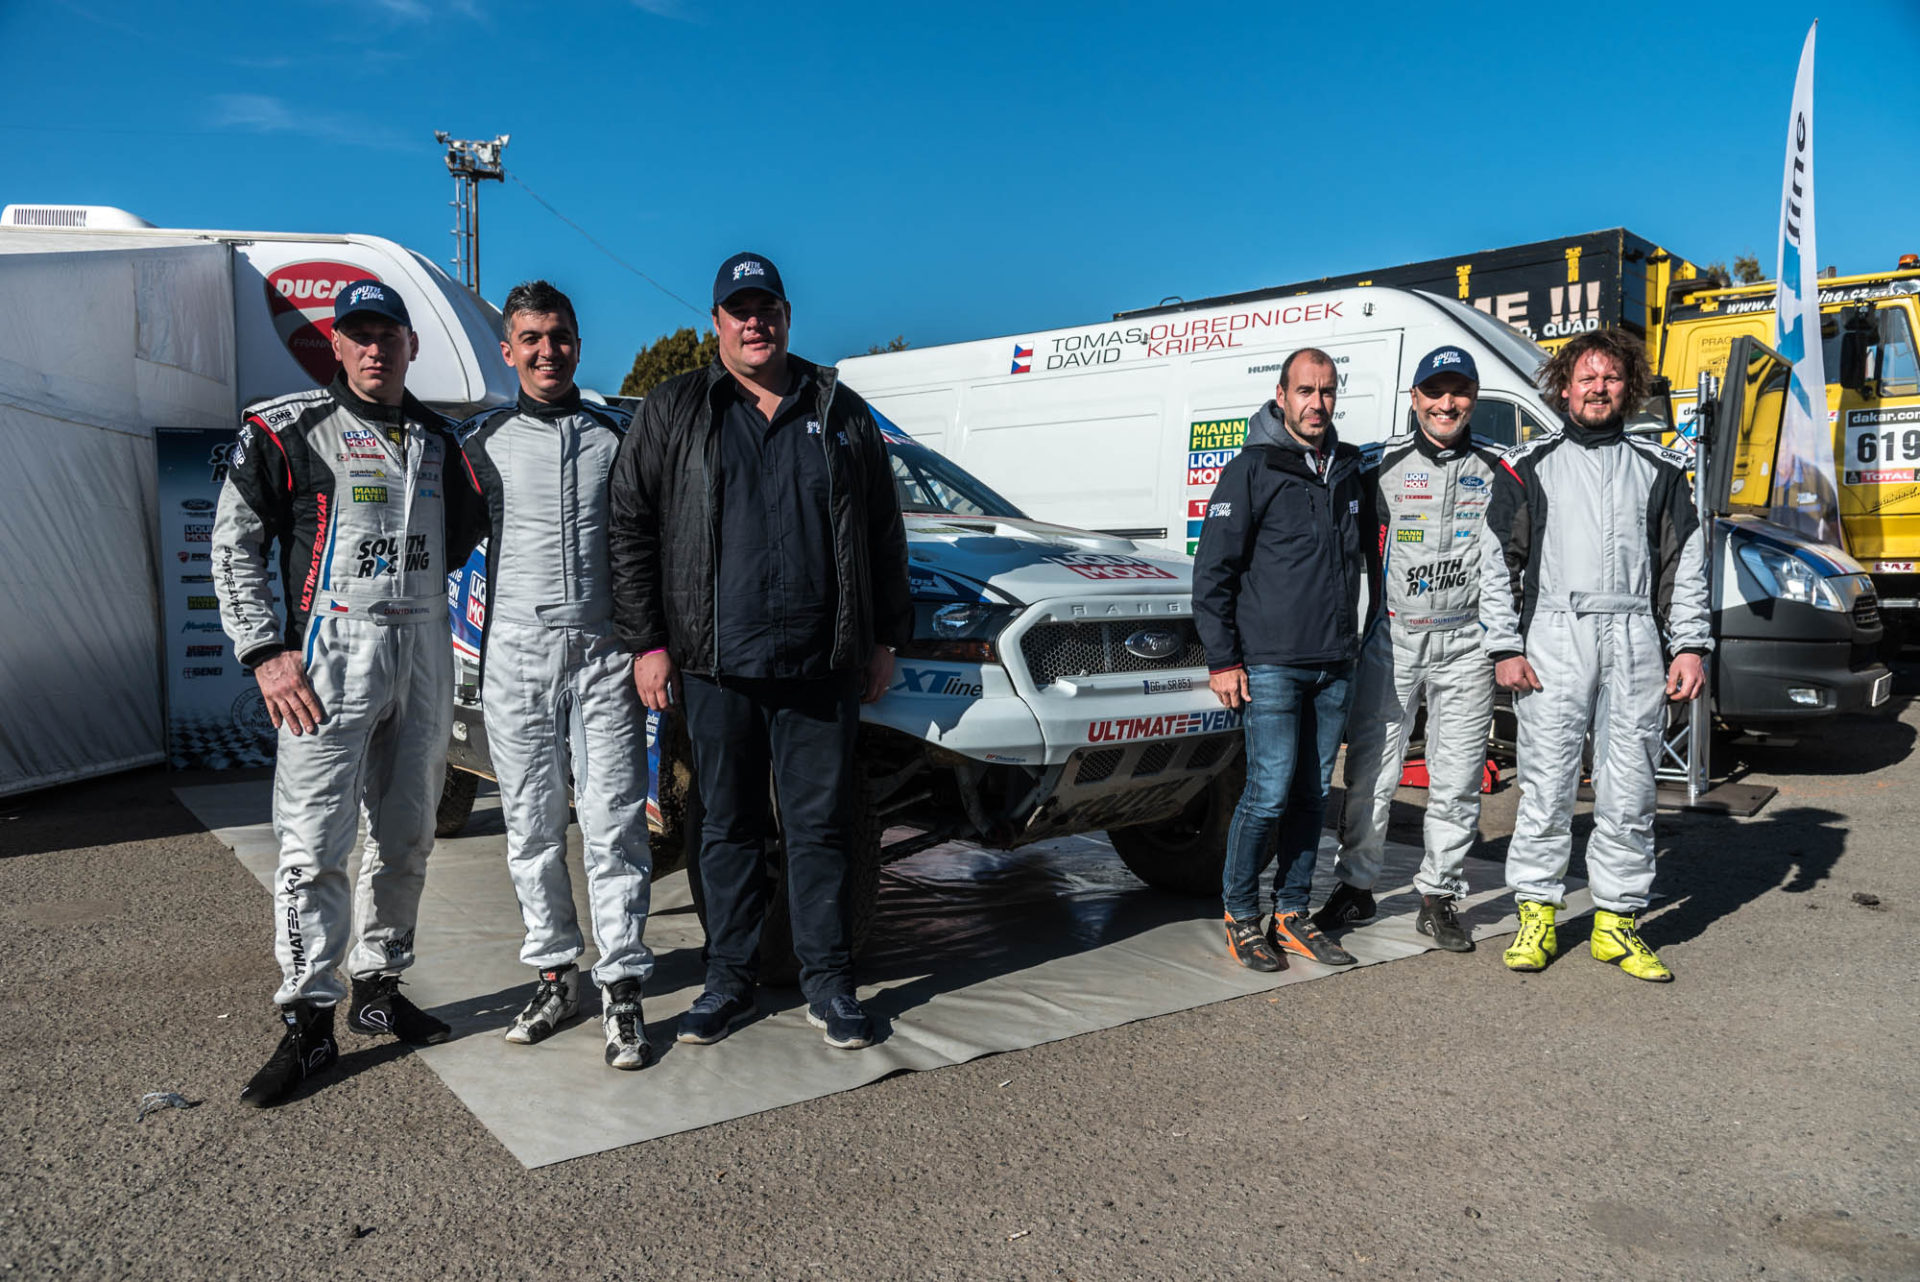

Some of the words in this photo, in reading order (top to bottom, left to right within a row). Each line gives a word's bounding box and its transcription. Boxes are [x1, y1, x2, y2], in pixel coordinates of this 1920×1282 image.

[275, 279, 355, 299] DUCA
[1052, 328, 1142, 353] TOMAS
[1150, 301, 1344, 341] OUREDNICEK
[1543, 318, 1600, 338] QUAD
[1047, 347, 1121, 370] DAVID
[1147, 333, 1243, 357] KRIPAL
[269, 411, 292, 424] OMP
[1193, 420, 1245, 436] MANN
[346, 439, 377, 447] MOLY
[1192, 433, 1245, 450] FILTER
[1661, 451, 1682, 461] OMP
[1189, 467, 1224, 484] MOL
[1405, 473, 1428, 481] LIQUI
[357, 534, 427, 559] SOUTH
[358, 552, 430, 580] RACING
[1072, 566, 1170, 578] MOLY
[1406, 558, 1463, 582] SOUTH
[471, 575, 486, 605] LIQ
[1406, 571, 1467, 597] RACING
[1150, 681, 1161, 692] GG
